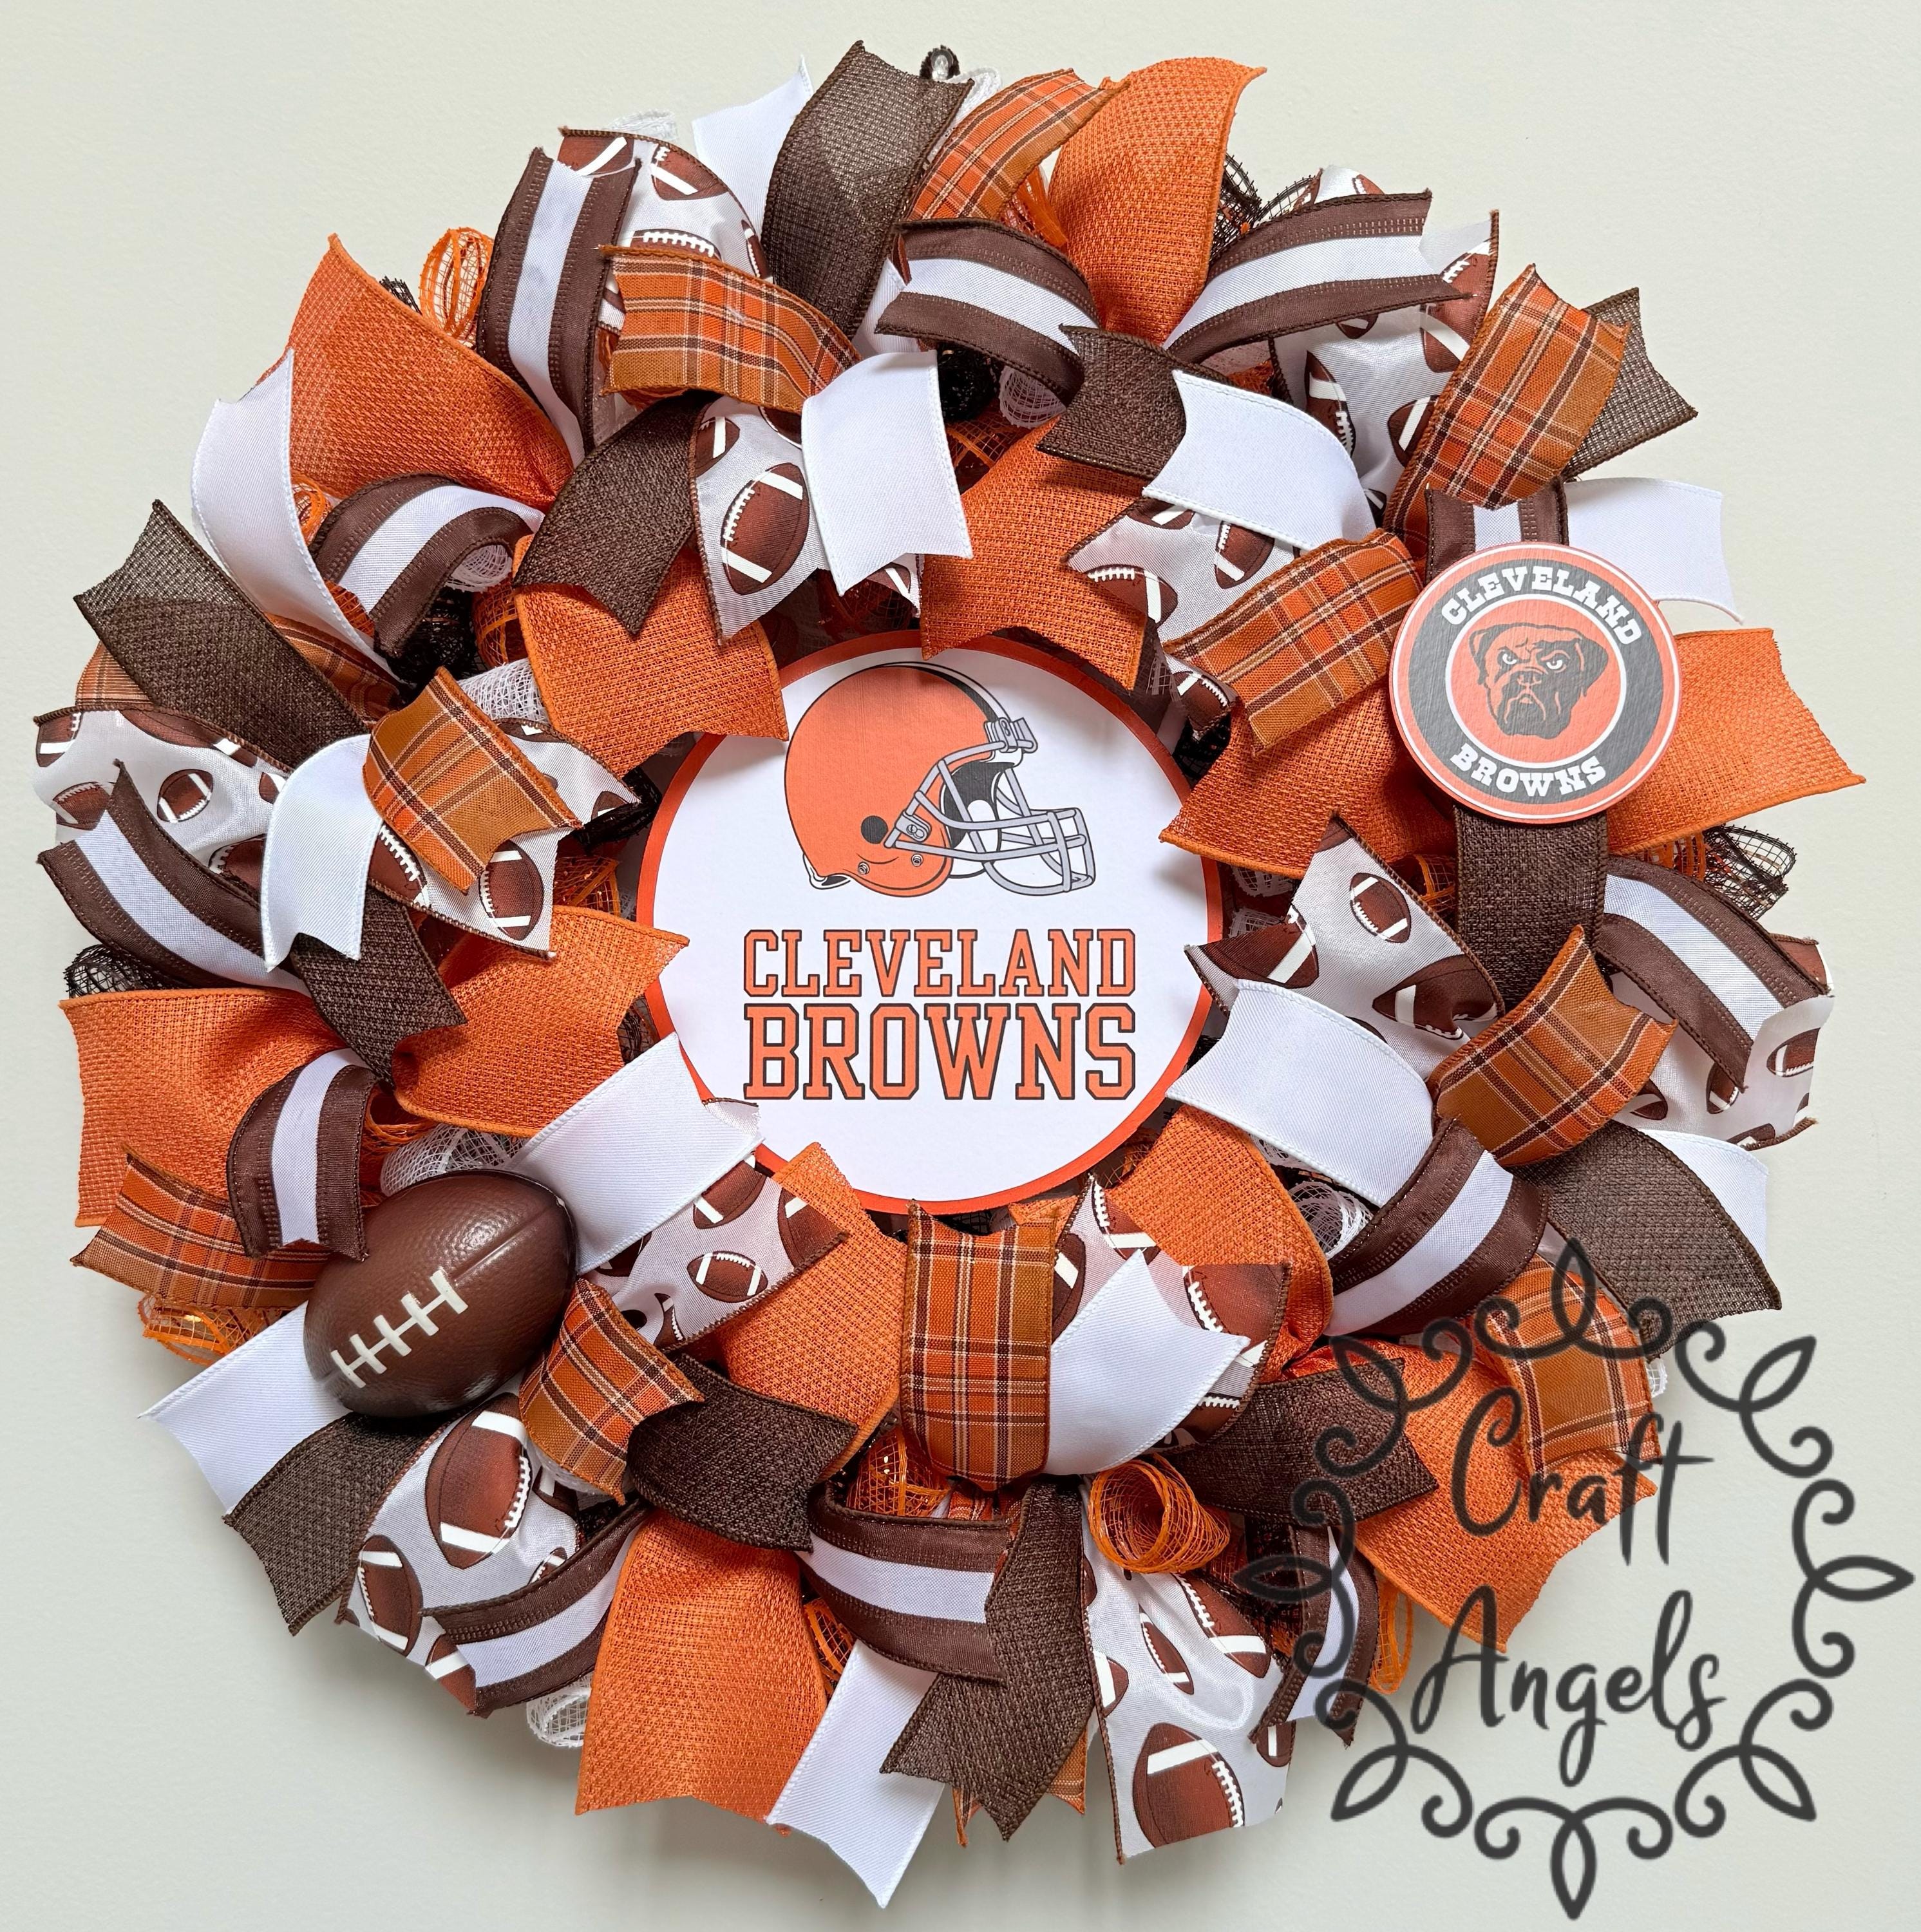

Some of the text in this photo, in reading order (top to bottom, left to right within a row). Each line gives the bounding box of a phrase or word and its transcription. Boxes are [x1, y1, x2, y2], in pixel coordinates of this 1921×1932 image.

[1441, 565, 1642, 645] CLEVELAND
[1450, 743, 1607, 797] BROWNS
[743, 929, 1135, 998] CLEVELAND
[743, 1003, 1135, 1101] BROWNS
